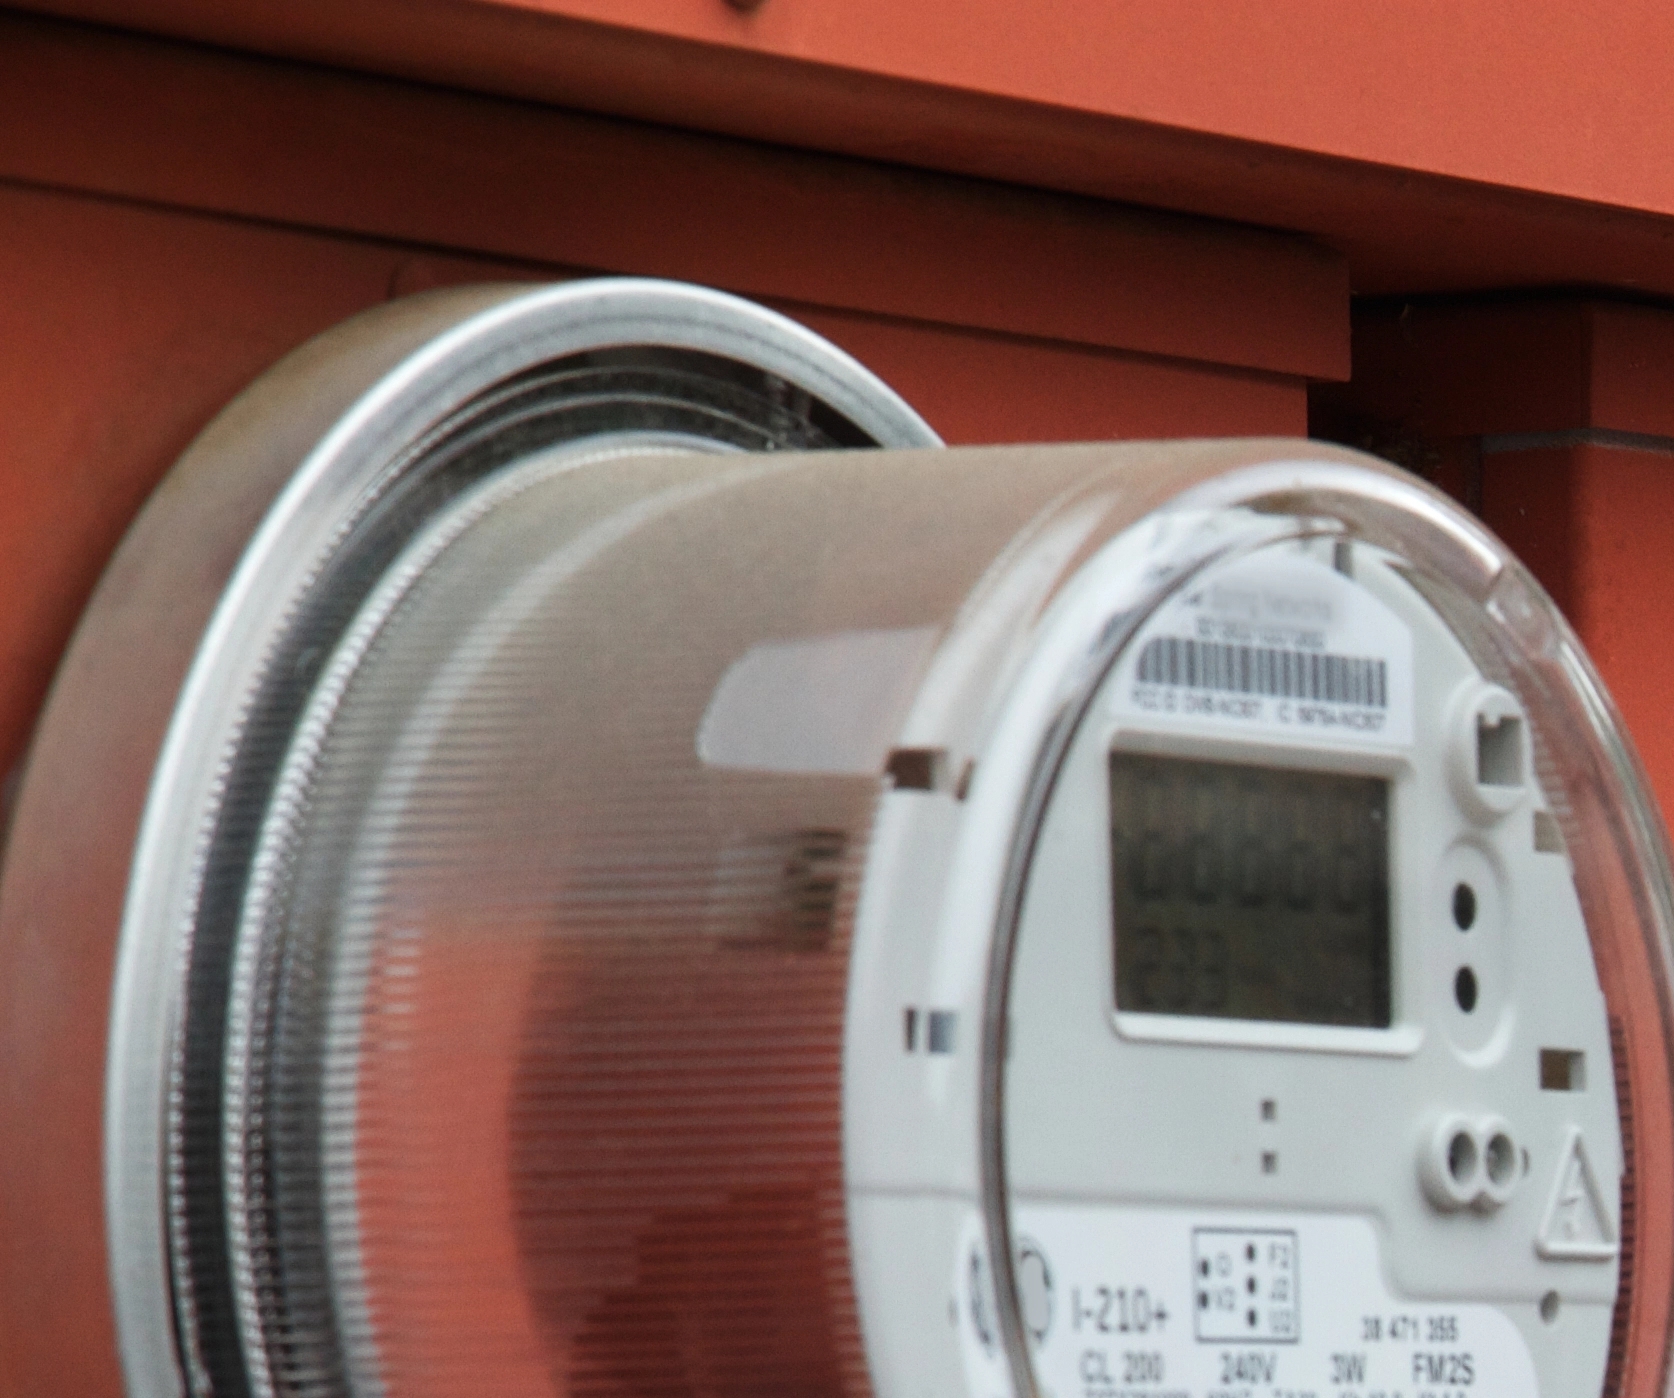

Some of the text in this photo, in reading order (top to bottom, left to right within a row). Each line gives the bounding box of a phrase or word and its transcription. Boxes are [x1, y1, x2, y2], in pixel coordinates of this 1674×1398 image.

[1071, 1285, 1170, 1334] I-210+
[1080, 1351, 1475, 1386] CL 200 240V 3W FM2S
